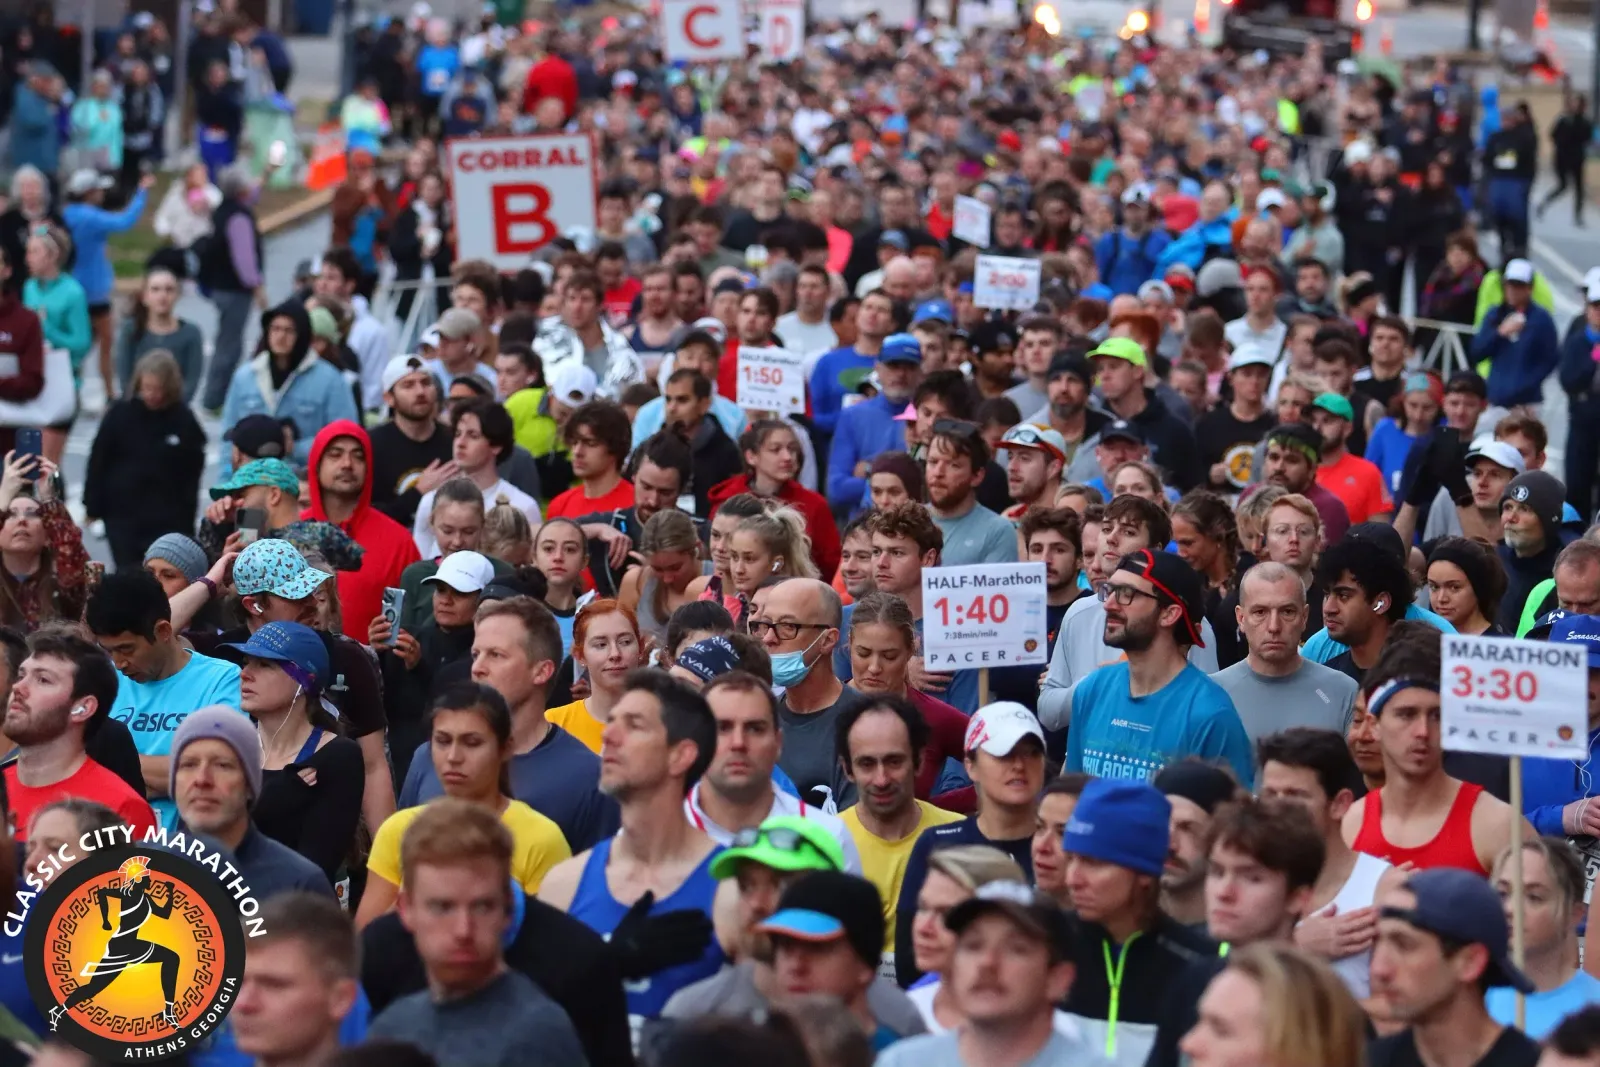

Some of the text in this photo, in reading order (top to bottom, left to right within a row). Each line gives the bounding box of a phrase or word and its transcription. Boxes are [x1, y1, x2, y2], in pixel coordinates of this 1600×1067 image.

[682, 5, 722, 49] C
[457, 146, 584, 173] CORRAL
[491, 182, 559, 255] B
[744, 366, 783, 386] 1:50
[928, 572, 1042, 589] HALF-Marathon
[934, 594, 1009, 627] 1:40
[930, 650, 1006, 664] PACER
[1450, 642, 1580, 667] MARATHON
[688, 657, 714, 679] VAIL
[1452, 664, 1538, 703] 3:30
[1449, 726, 1539, 744] PACER
